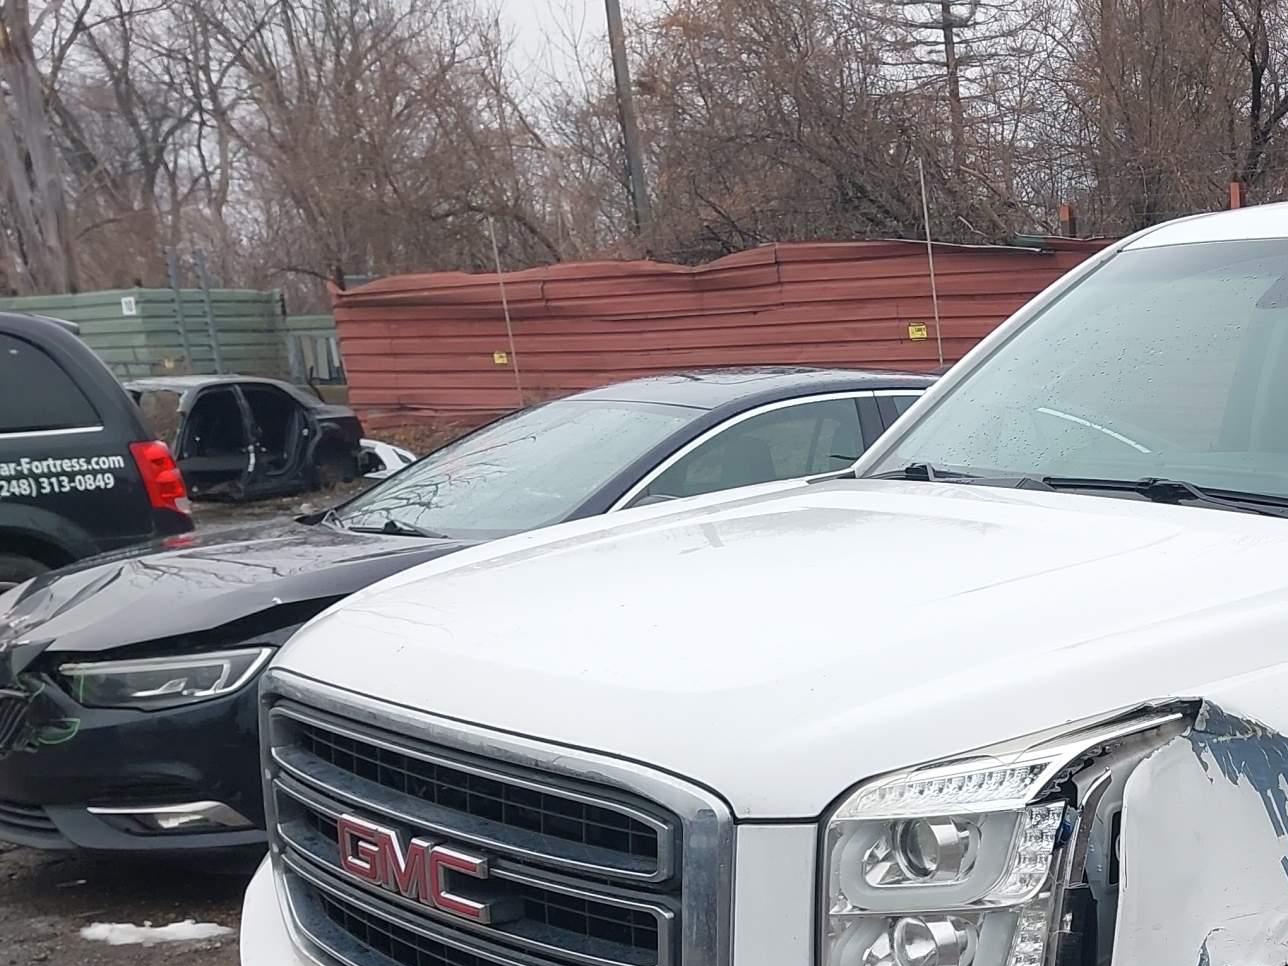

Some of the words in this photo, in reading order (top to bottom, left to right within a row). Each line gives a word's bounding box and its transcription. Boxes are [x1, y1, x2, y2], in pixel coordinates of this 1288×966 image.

[0, 477, 36, 498] 248)
[39, 473, 115, 494] 313-0849
[337, 813, 491, 925] GMC
